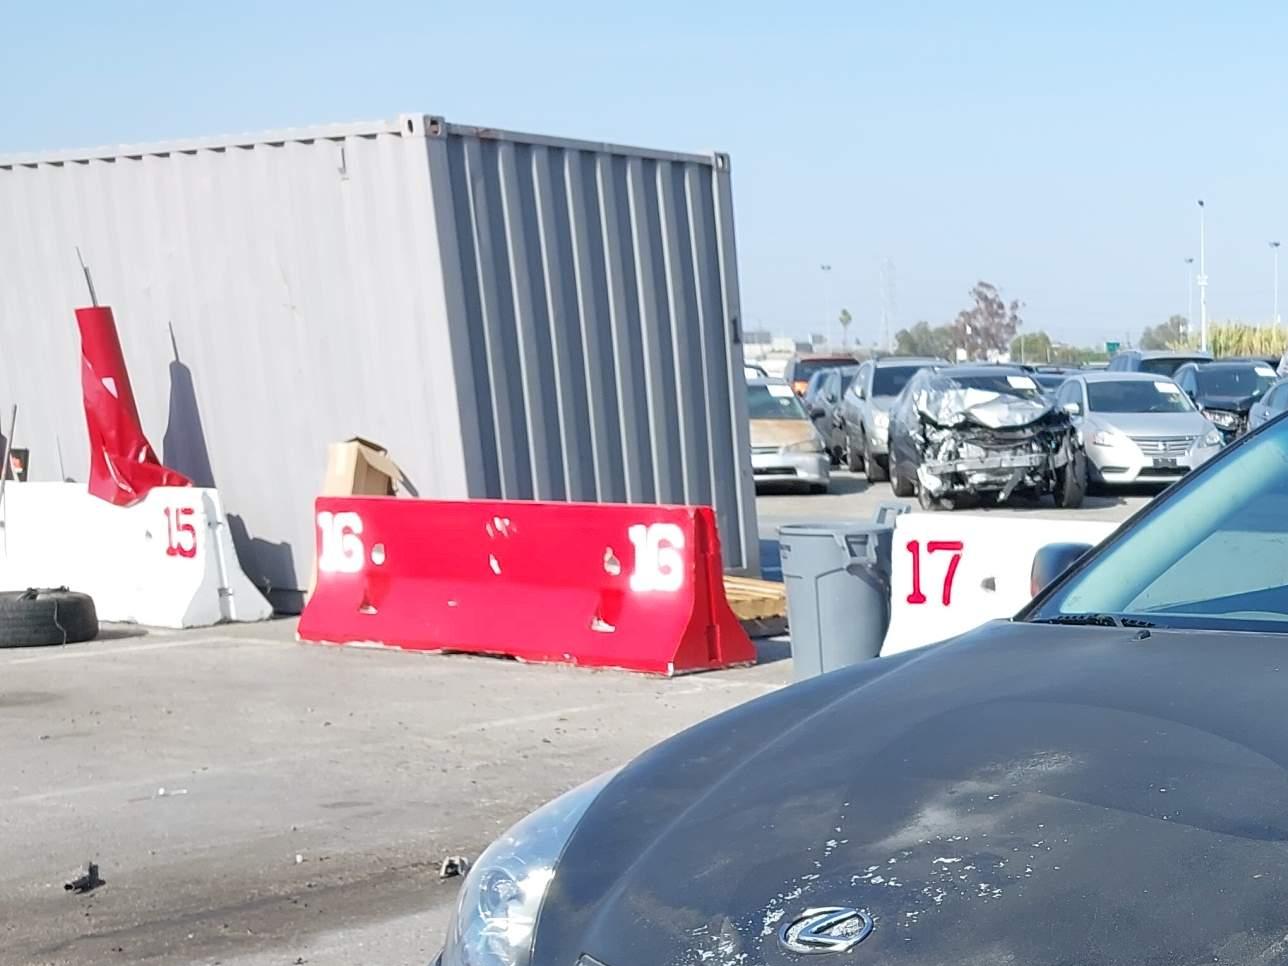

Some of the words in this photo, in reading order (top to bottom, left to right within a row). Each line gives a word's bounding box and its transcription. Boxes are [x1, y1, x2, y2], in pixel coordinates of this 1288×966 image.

[164, 507, 197, 557] 15
[317, 512, 363, 572] 16
[628, 524, 687, 592] 16
[906, 540, 963, 606] 17
